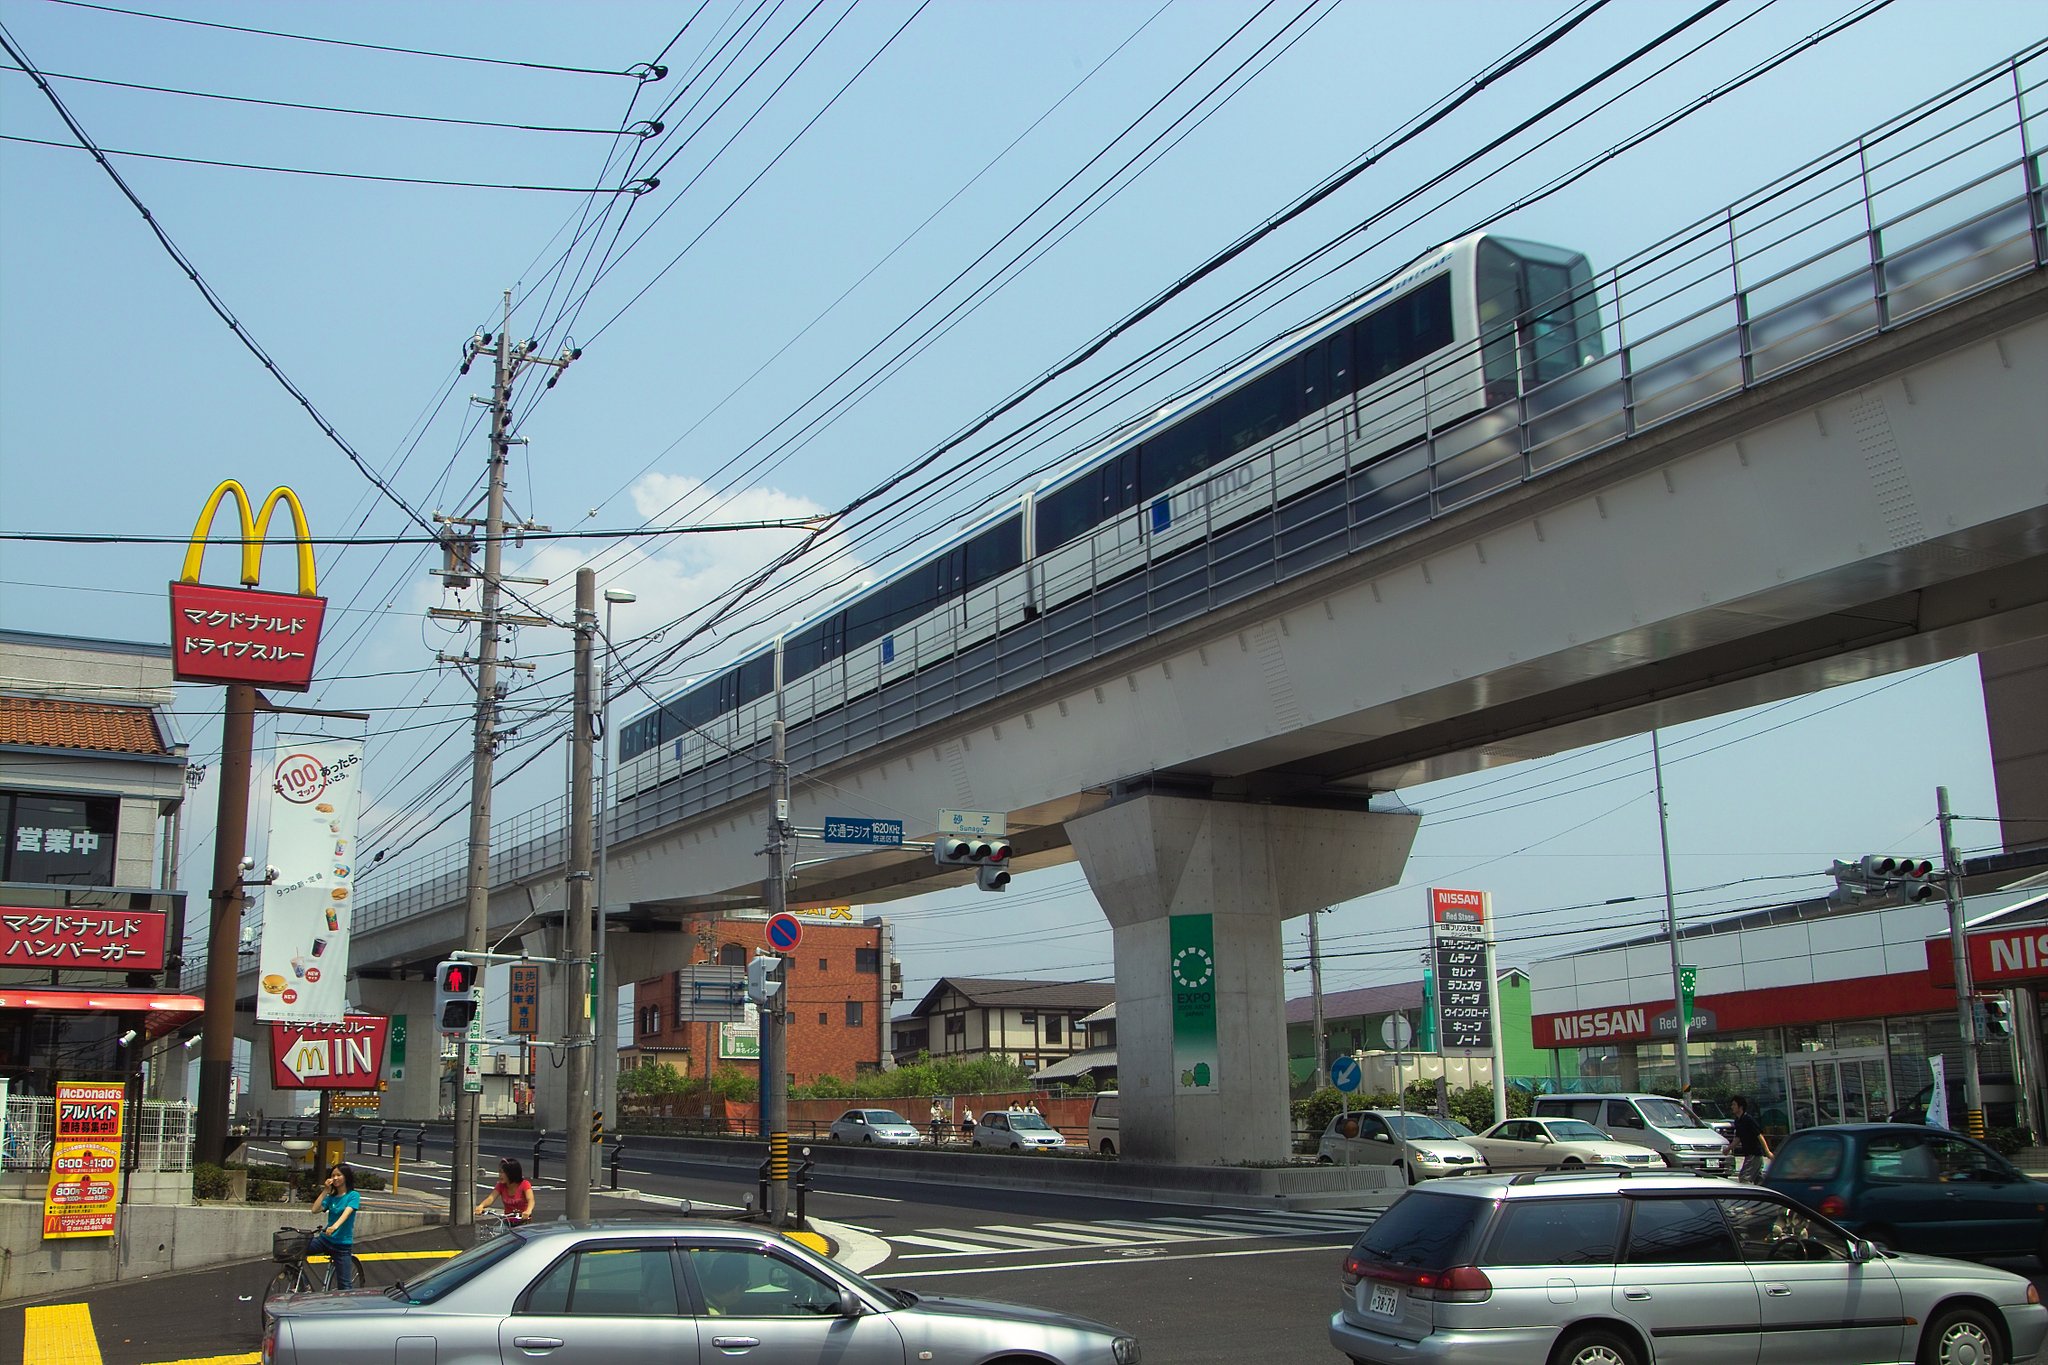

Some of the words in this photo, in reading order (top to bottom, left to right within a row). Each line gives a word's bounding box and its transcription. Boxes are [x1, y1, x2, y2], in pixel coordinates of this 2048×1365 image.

[1172, 463, 1254, 525] Linimo
[183, 608, 306, 635] マクドナルド
[183, 636, 305, 661] ドライブスルー
[827, 823, 871, 839] 交通ラジオ
[959, 824, 985, 833] Sunago
[16, 826, 99, 855] 営業中
[1438, 892, 1479, 905] NISSAN
[2, 914, 142, 939] マクドナルド
[6, 939, 146, 961] ハンバーガー
[1449, 953, 1478, 964] ムラーノ
[1451, 967, 1477, 978] セレナ
[1447, 980, 1482, 991] ラフェスタ
[1177, 992, 1211, 1004] EXPO
[1450, 993, 1481, 1005] ティーダ
[1453, 1021, 1483, 1032] キューブ
[1553, 1008, 1646, 1041] NISSAN
[1659, 1016, 1678, 1030] Red
[1457, 1034, 1481, 1046] ノート
[334, 1037, 372, 1075] IN
[60, 1088, 122, 1099] McDonald's
[61, 1104, 117, 1120] アルバイト
